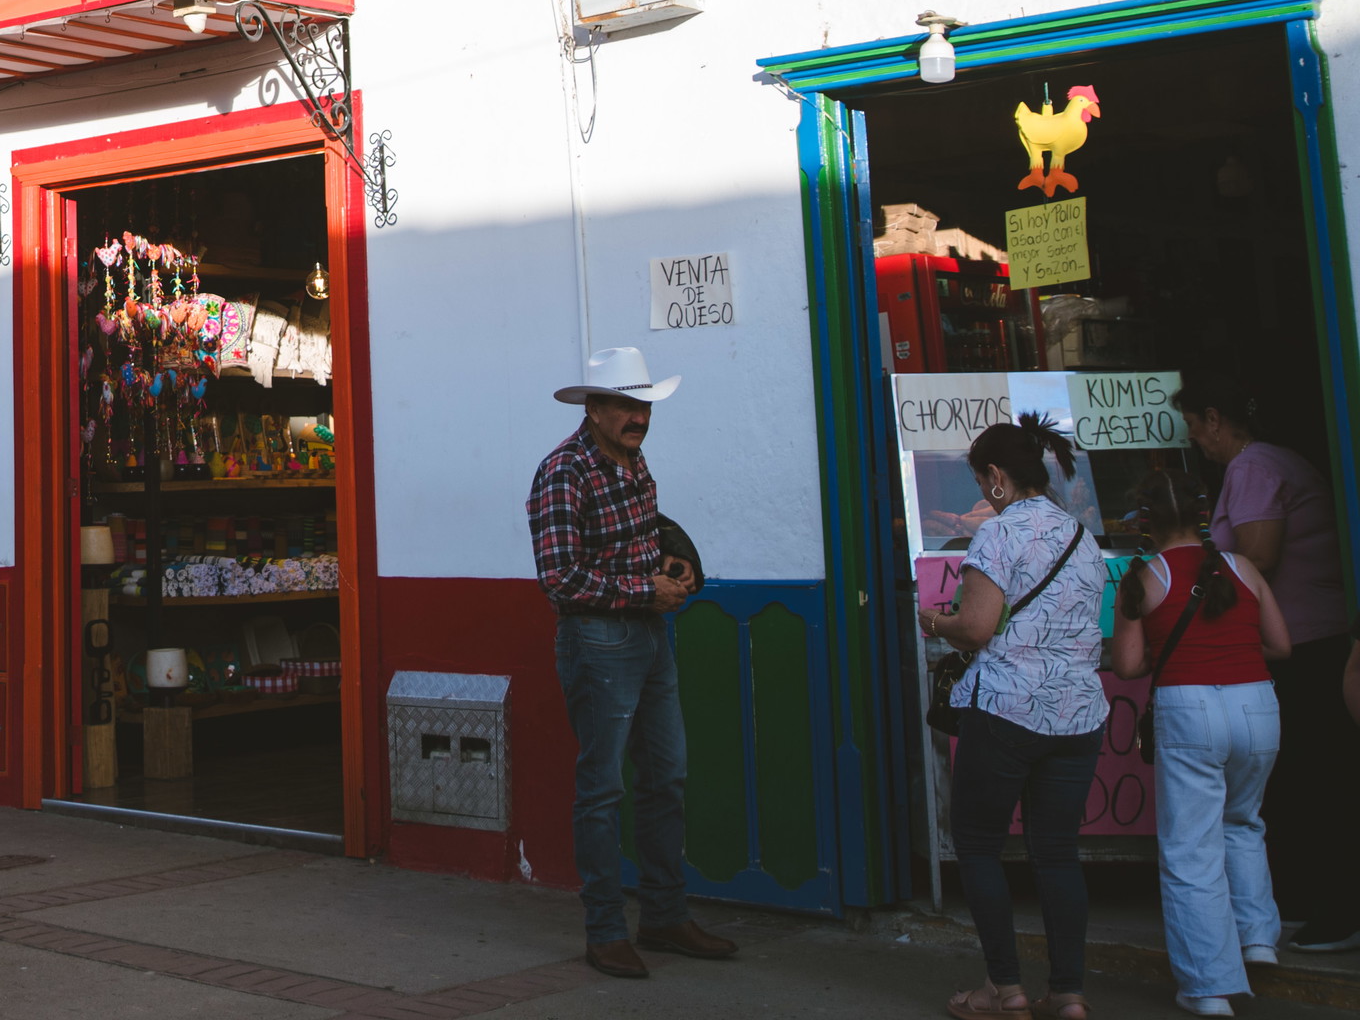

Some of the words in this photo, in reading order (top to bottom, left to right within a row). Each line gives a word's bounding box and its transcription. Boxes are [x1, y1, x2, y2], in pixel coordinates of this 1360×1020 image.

[1051, 203, 1081, 223] Pollo
[660, 255, 729, 287] VENTA
[682, 285, 705, 306] DE
[667, 302, 733, 328] QUESO
[1086, 377, 1167, 408] KUMIS
[900, 396, 1013, 441] CHORIZOS
[1076, 411, 1174, 446] CASERO
